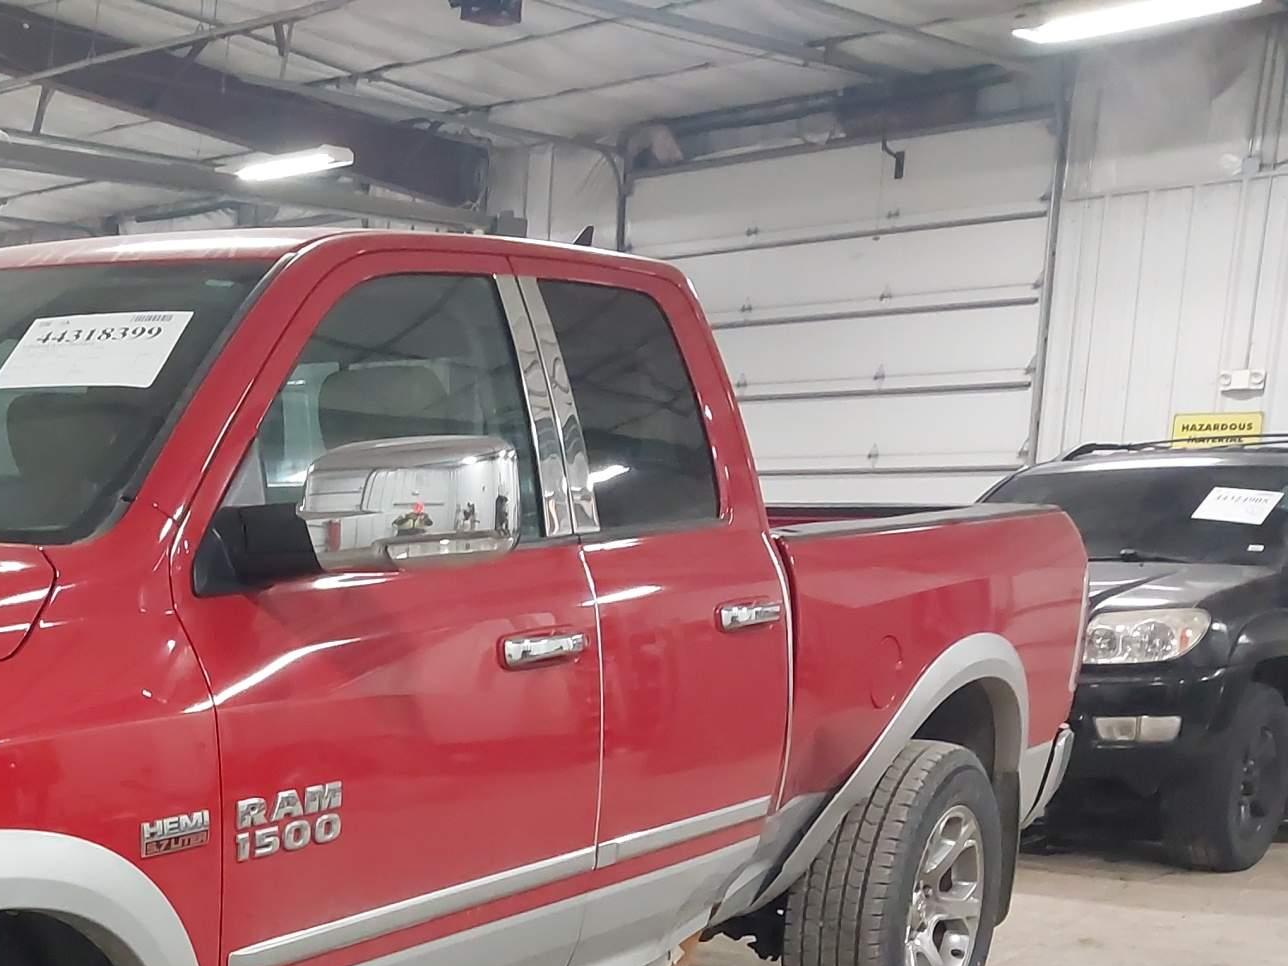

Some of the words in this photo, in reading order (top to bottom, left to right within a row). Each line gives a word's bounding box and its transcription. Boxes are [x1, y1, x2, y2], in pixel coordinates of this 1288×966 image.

[36, 326, 162, 344] 44318399
[1181, 422, 1253, 432] HAZARDOUS
[237, 780, 343, 831] RAM
[142, 809, 209, 840] HEMI
[236, 812, 342, 862] 1500
